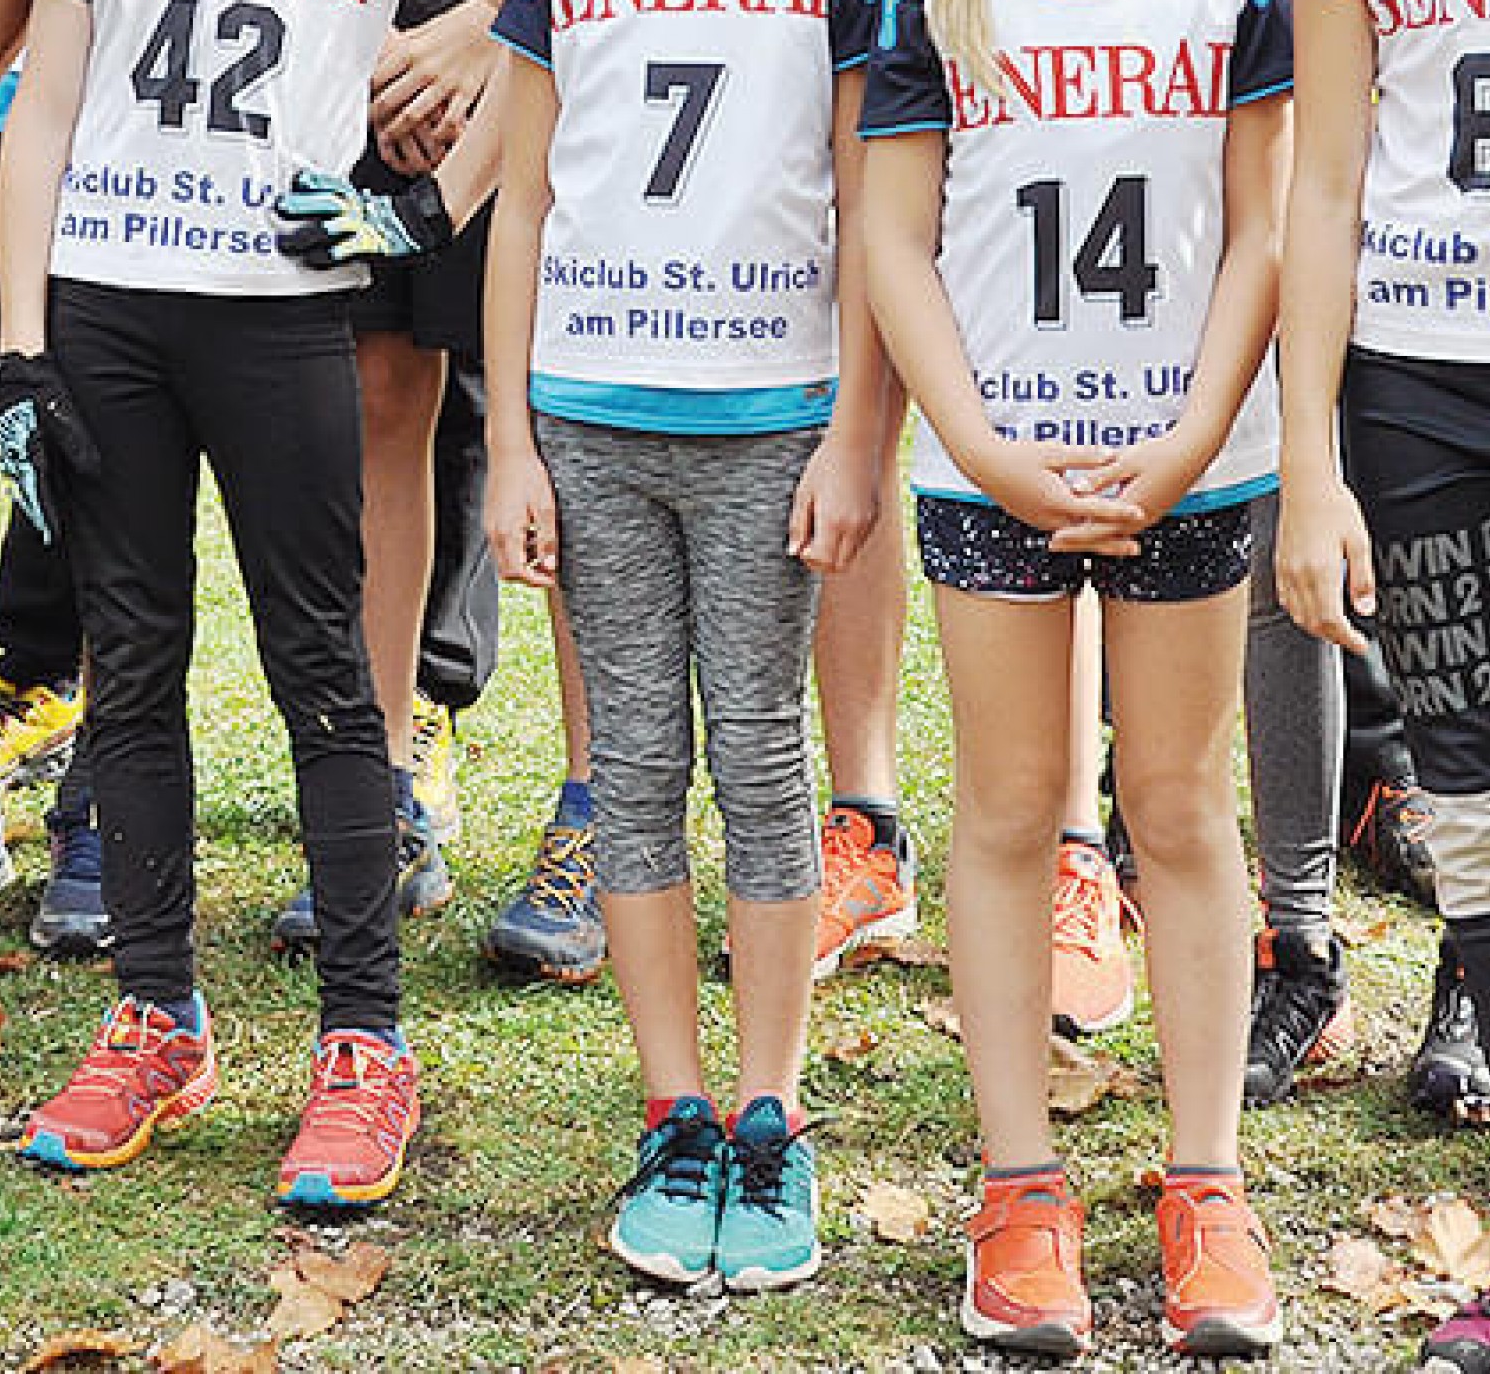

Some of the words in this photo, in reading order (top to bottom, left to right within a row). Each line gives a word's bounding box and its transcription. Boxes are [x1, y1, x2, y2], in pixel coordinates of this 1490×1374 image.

[643, 60, 727, 199] 7
[171, 170, 226, 204] St.
[61, 213, 109, 240] am
[124, 213, 278, 254] Pillerse
[1015, 174, 1159, 323] 14
[663, 259, 717, 292] St.
[1367, 278, 1430, 308] am
[565, 312, 616, 337] am
[626, 308, 789, 340] Pillersee
[1073, 369, 1129, 400] St.
[1454, 572, 1483, 617] 2
